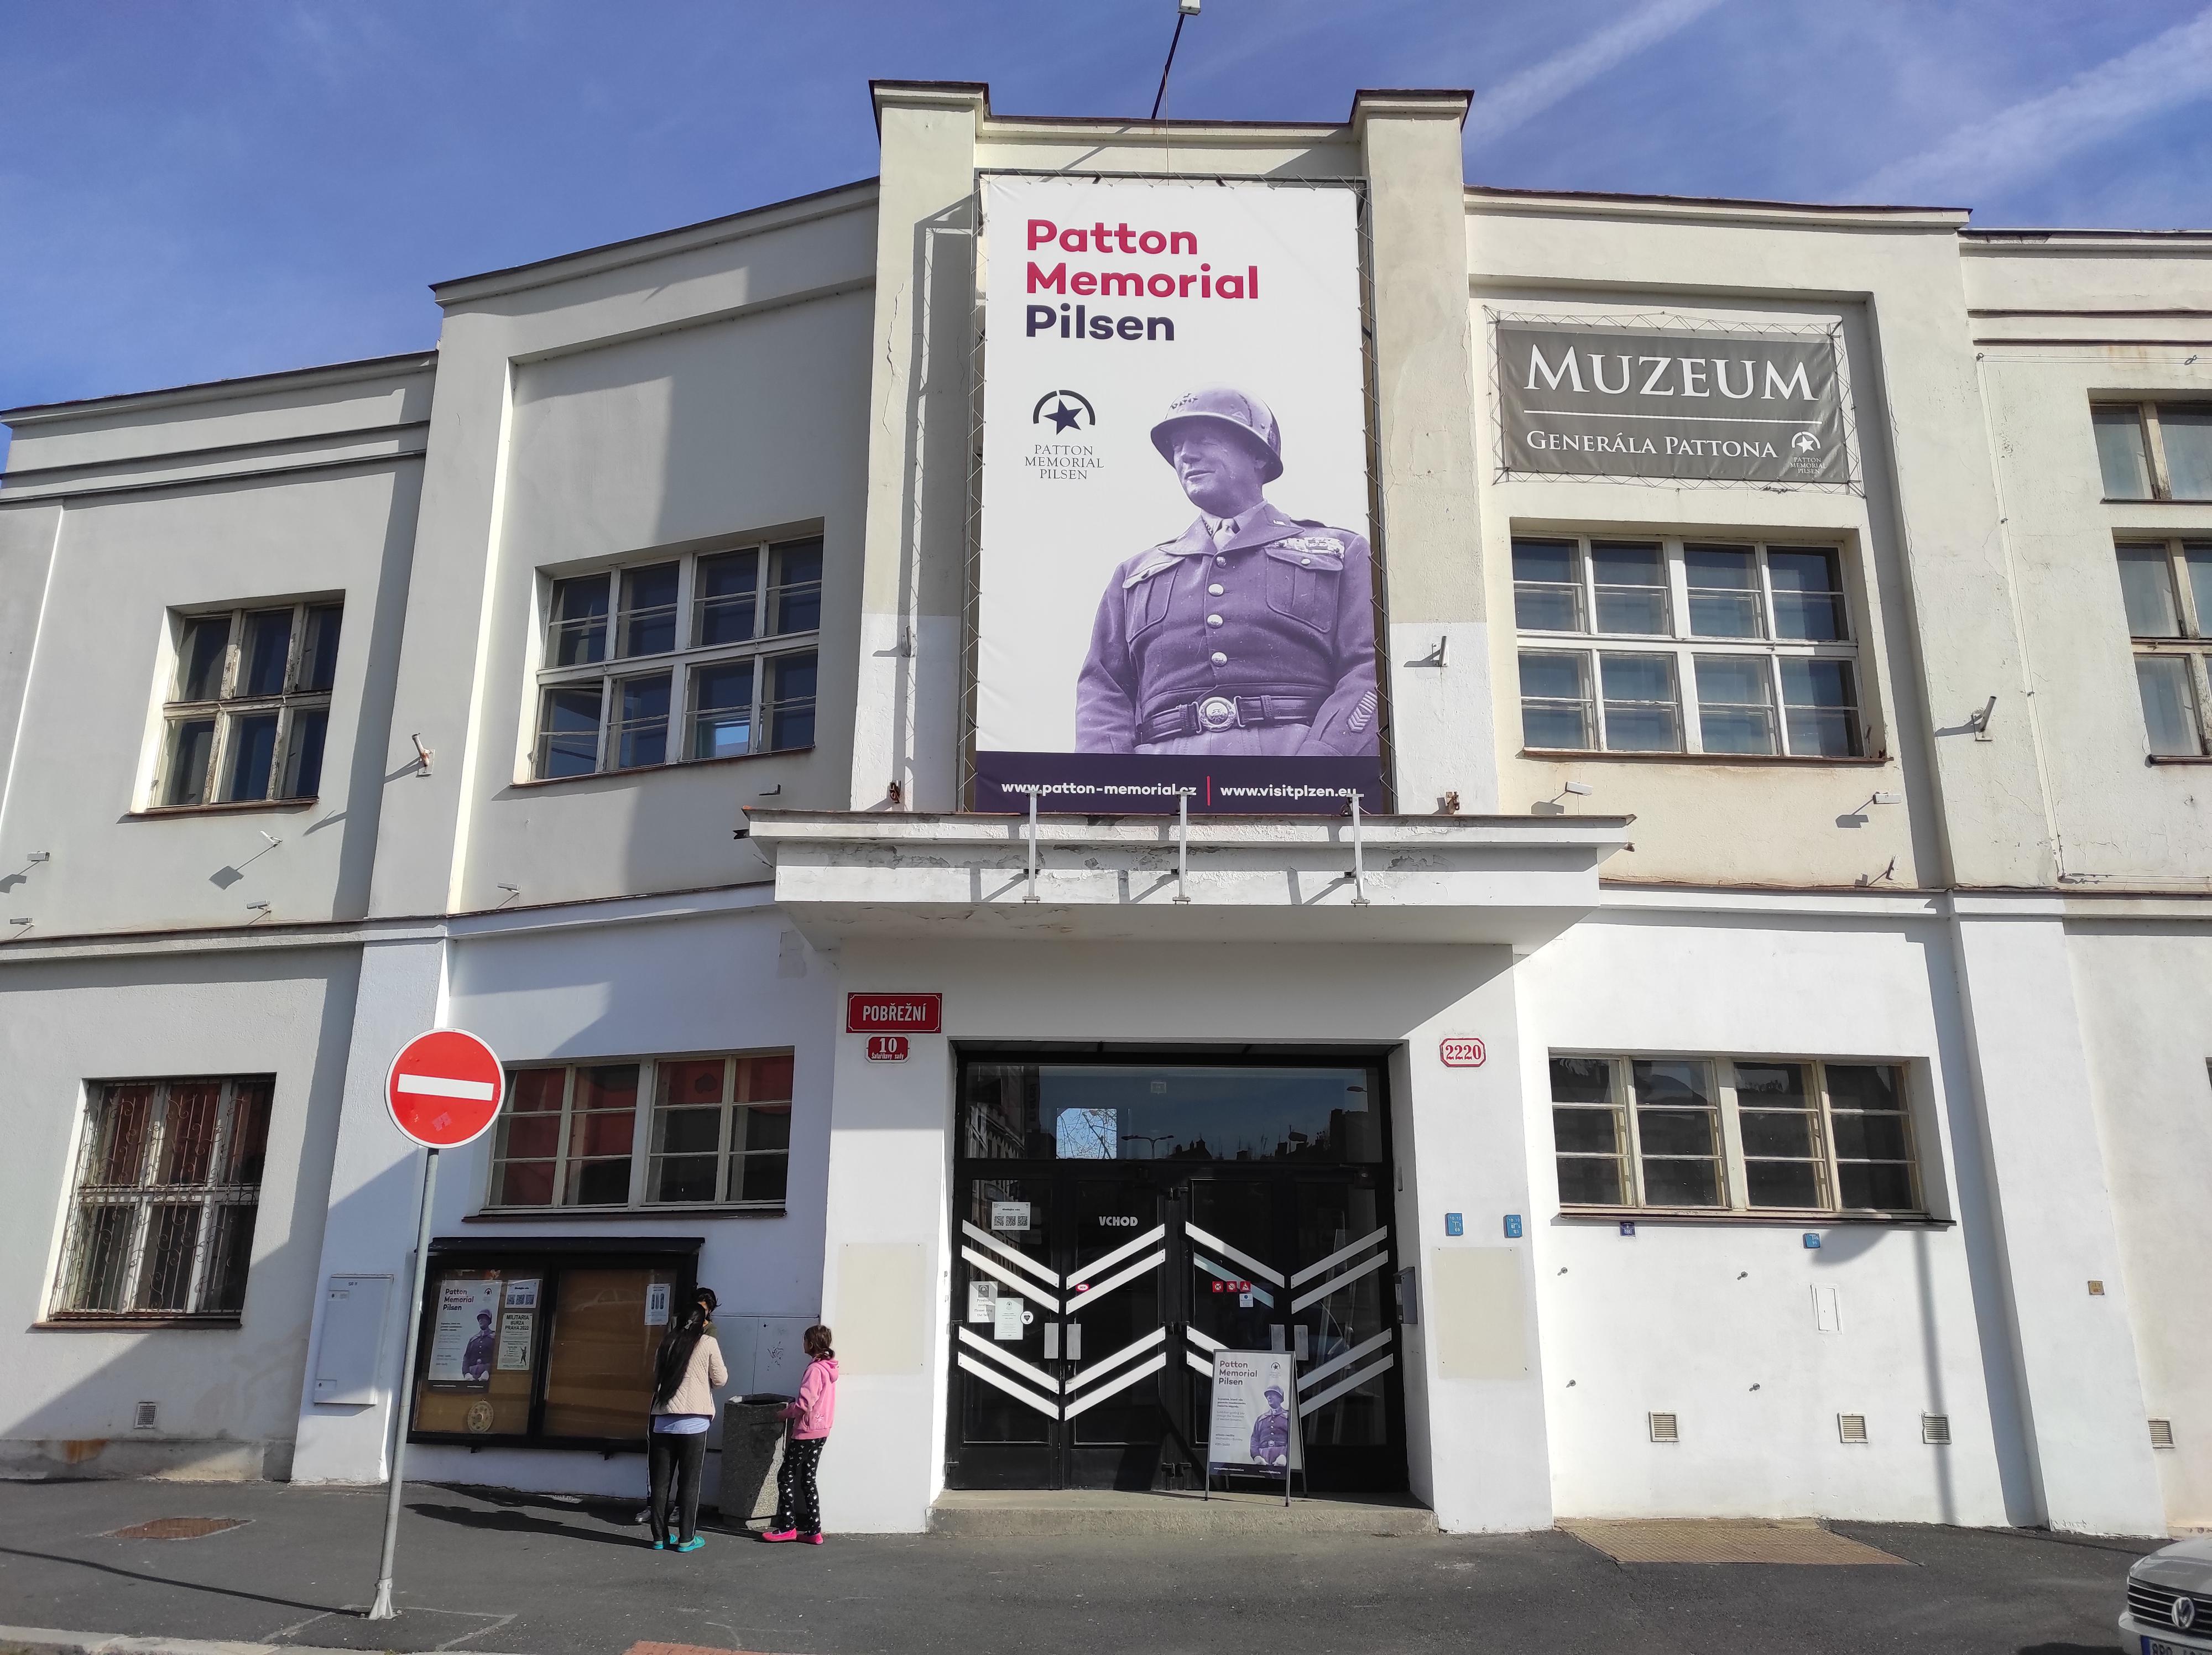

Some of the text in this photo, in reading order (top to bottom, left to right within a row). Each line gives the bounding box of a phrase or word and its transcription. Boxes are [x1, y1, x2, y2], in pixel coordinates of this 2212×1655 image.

[1027, 219, 1197, 254] Patton
[1026, 262, 1258, 299] Memorial
[1026, 302, 1175, 341] Pilsen
[1524, 344, 1819, 400] MUZEUM
[1035, 444, 1093, 455] PATTON
[1527, 430, 1778, 458] GENERÁLA PATTONA
[1025, 456, 1104, 468] MEMORIAL
[1040, 469, 1087, 479] PILSEN
[1001, 782, 1357, 799] www.patton-memorial.cz www.visitplzen.eu
[863, 1003, 927, 1021] POBŘEŽNÍ
[879, 1038, 897, 1052] 10
[1446, 1045, 1481, 1060] 2220
[1098, 1216, 1138, 1226] VCHOD
[1220, 1360, 1248, 1369] Patton
